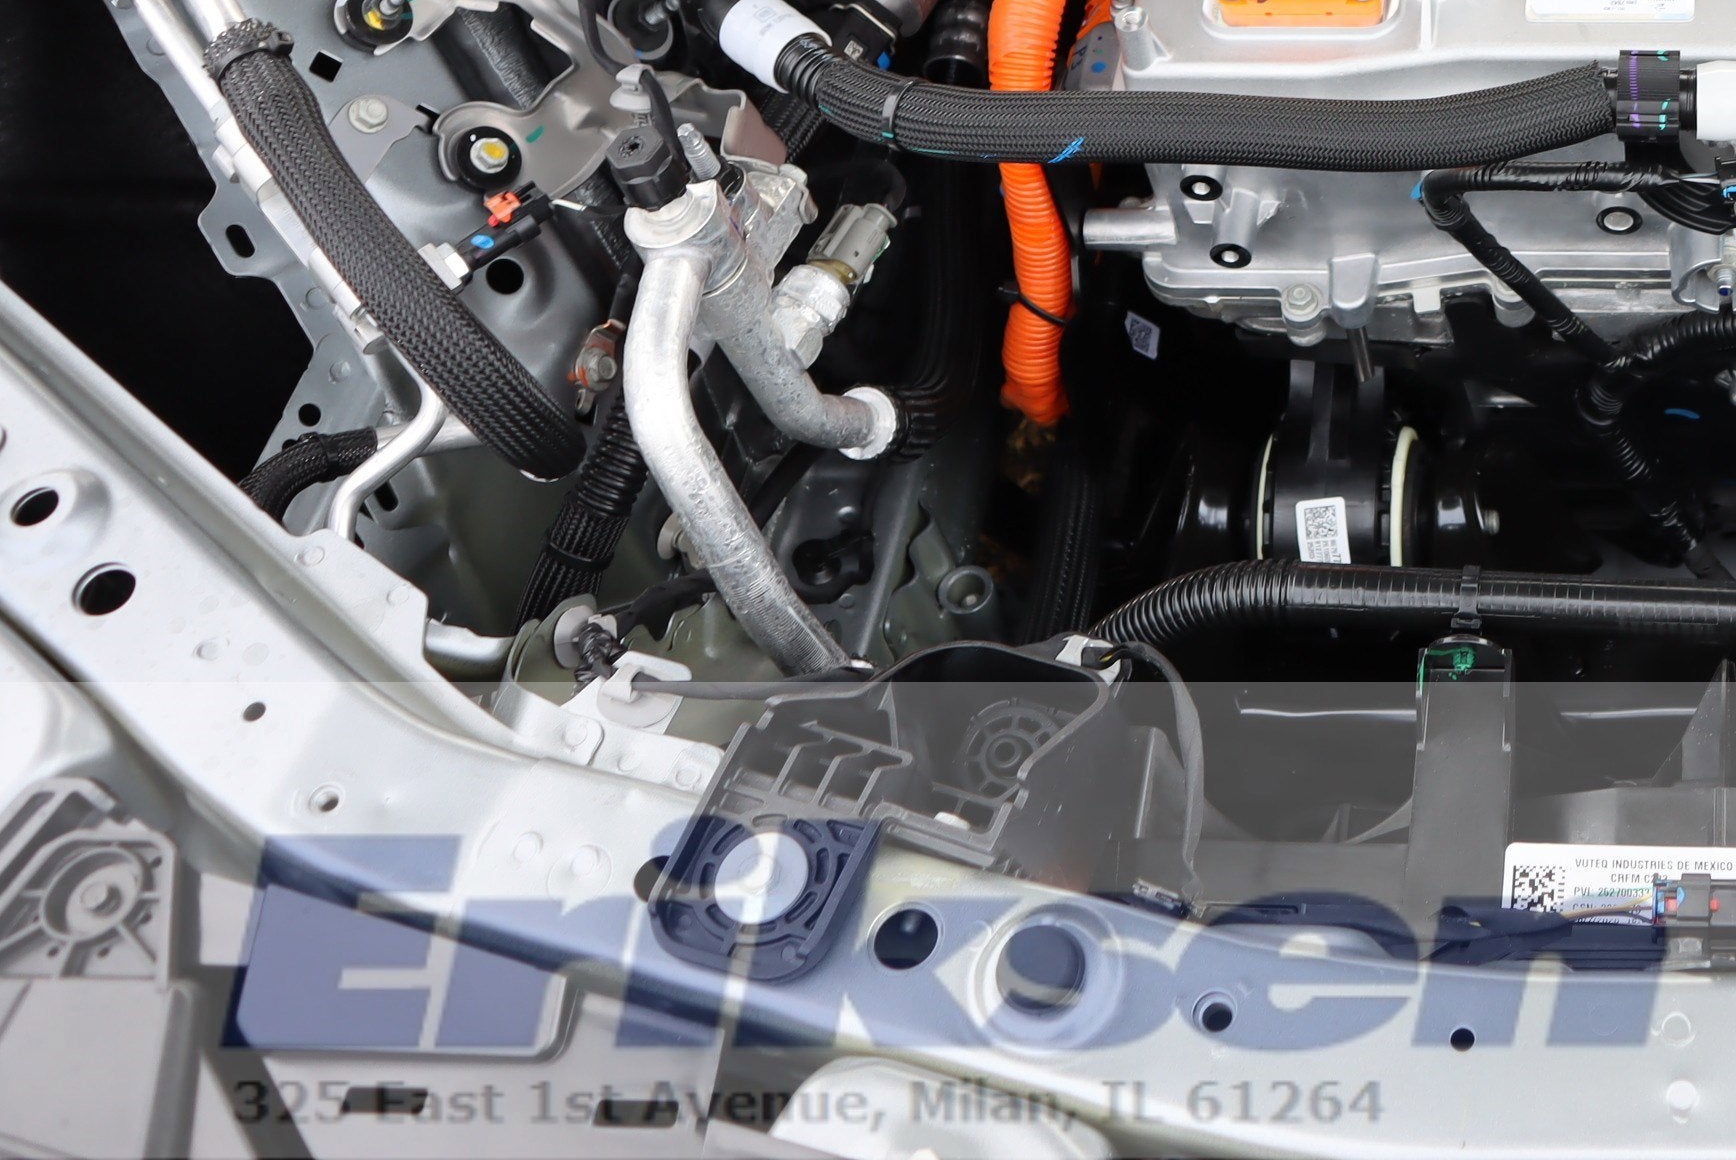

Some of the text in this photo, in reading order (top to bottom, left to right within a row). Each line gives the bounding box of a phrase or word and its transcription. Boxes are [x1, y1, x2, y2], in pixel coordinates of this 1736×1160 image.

[1575, 859, 1733, 871] VUTEQ INDUSTRIES DE MEXICO
[1610, 873, 1644, 883] CRFM
